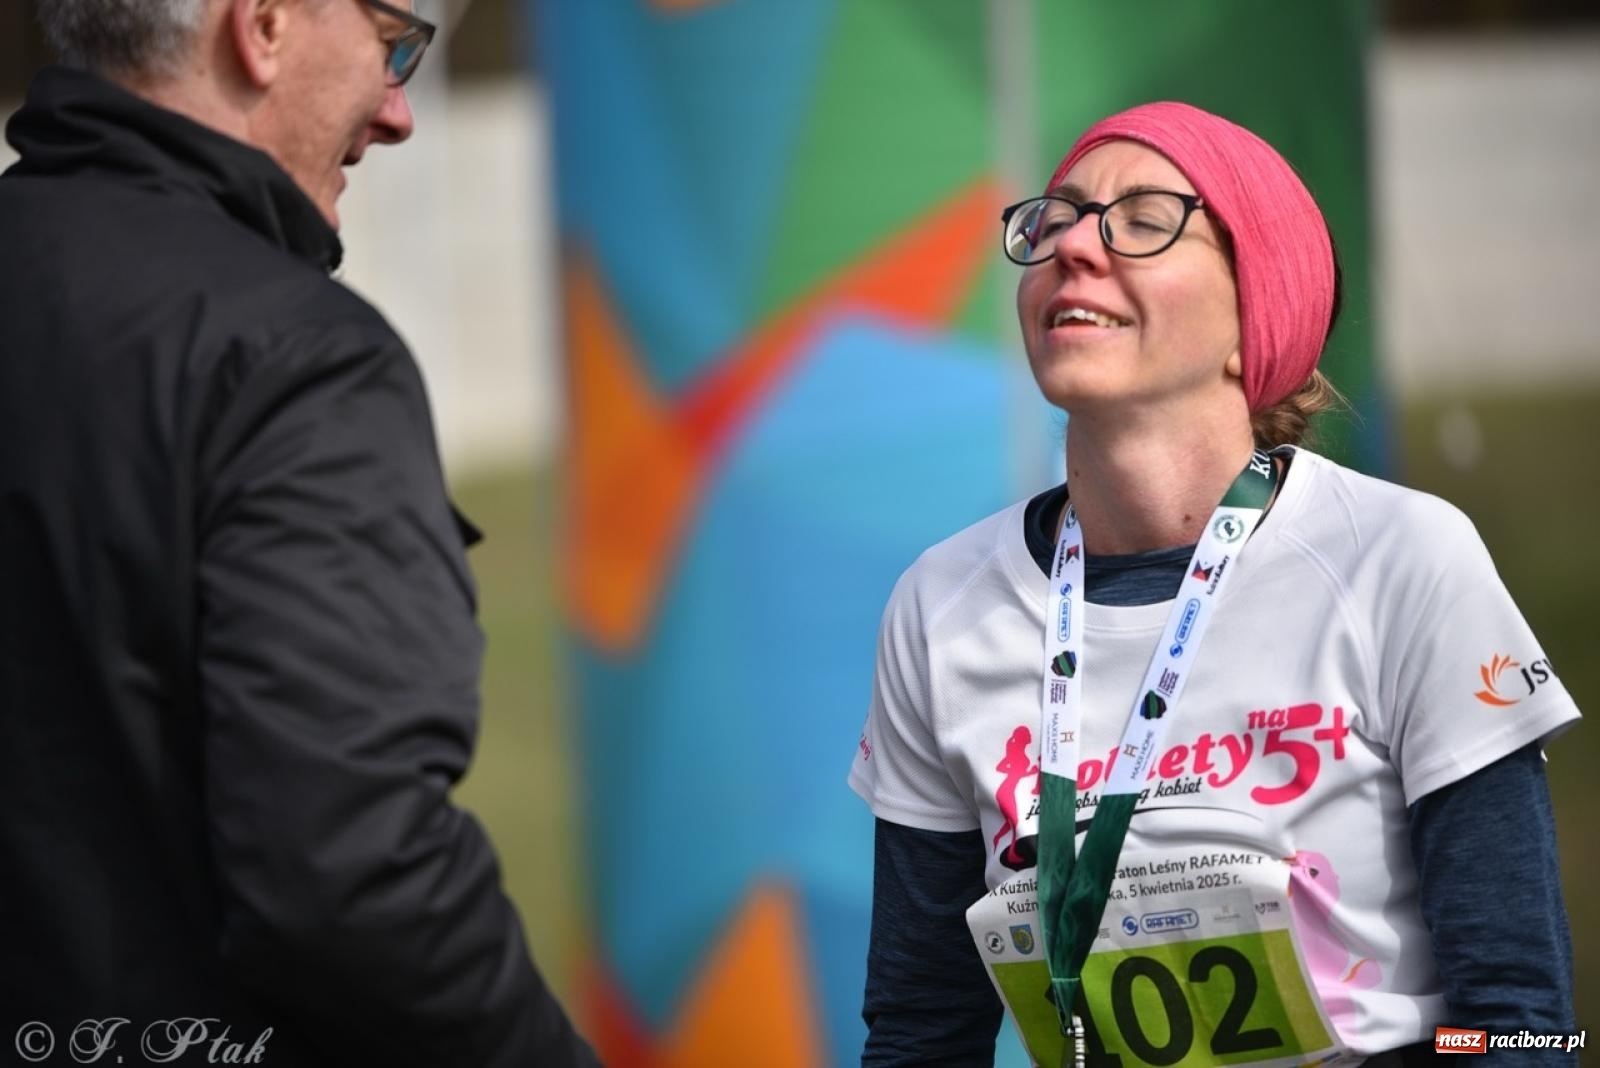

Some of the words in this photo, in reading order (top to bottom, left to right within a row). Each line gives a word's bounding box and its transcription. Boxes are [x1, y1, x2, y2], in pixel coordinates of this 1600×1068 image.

[1248, 708, 1286, 730] na
[1153, 777, 1203, 798] kobiet
[1149, 860, 1186, 874] Leśny
[1189, 853, 1264, 870] RAFAMET
[1129, 883, 1137, 898] 5
[1139, 877, 1195, 897] kwietnia
[1196, 872, 1230, 889] 2025
[1233, 874, 1242, 885] r.
